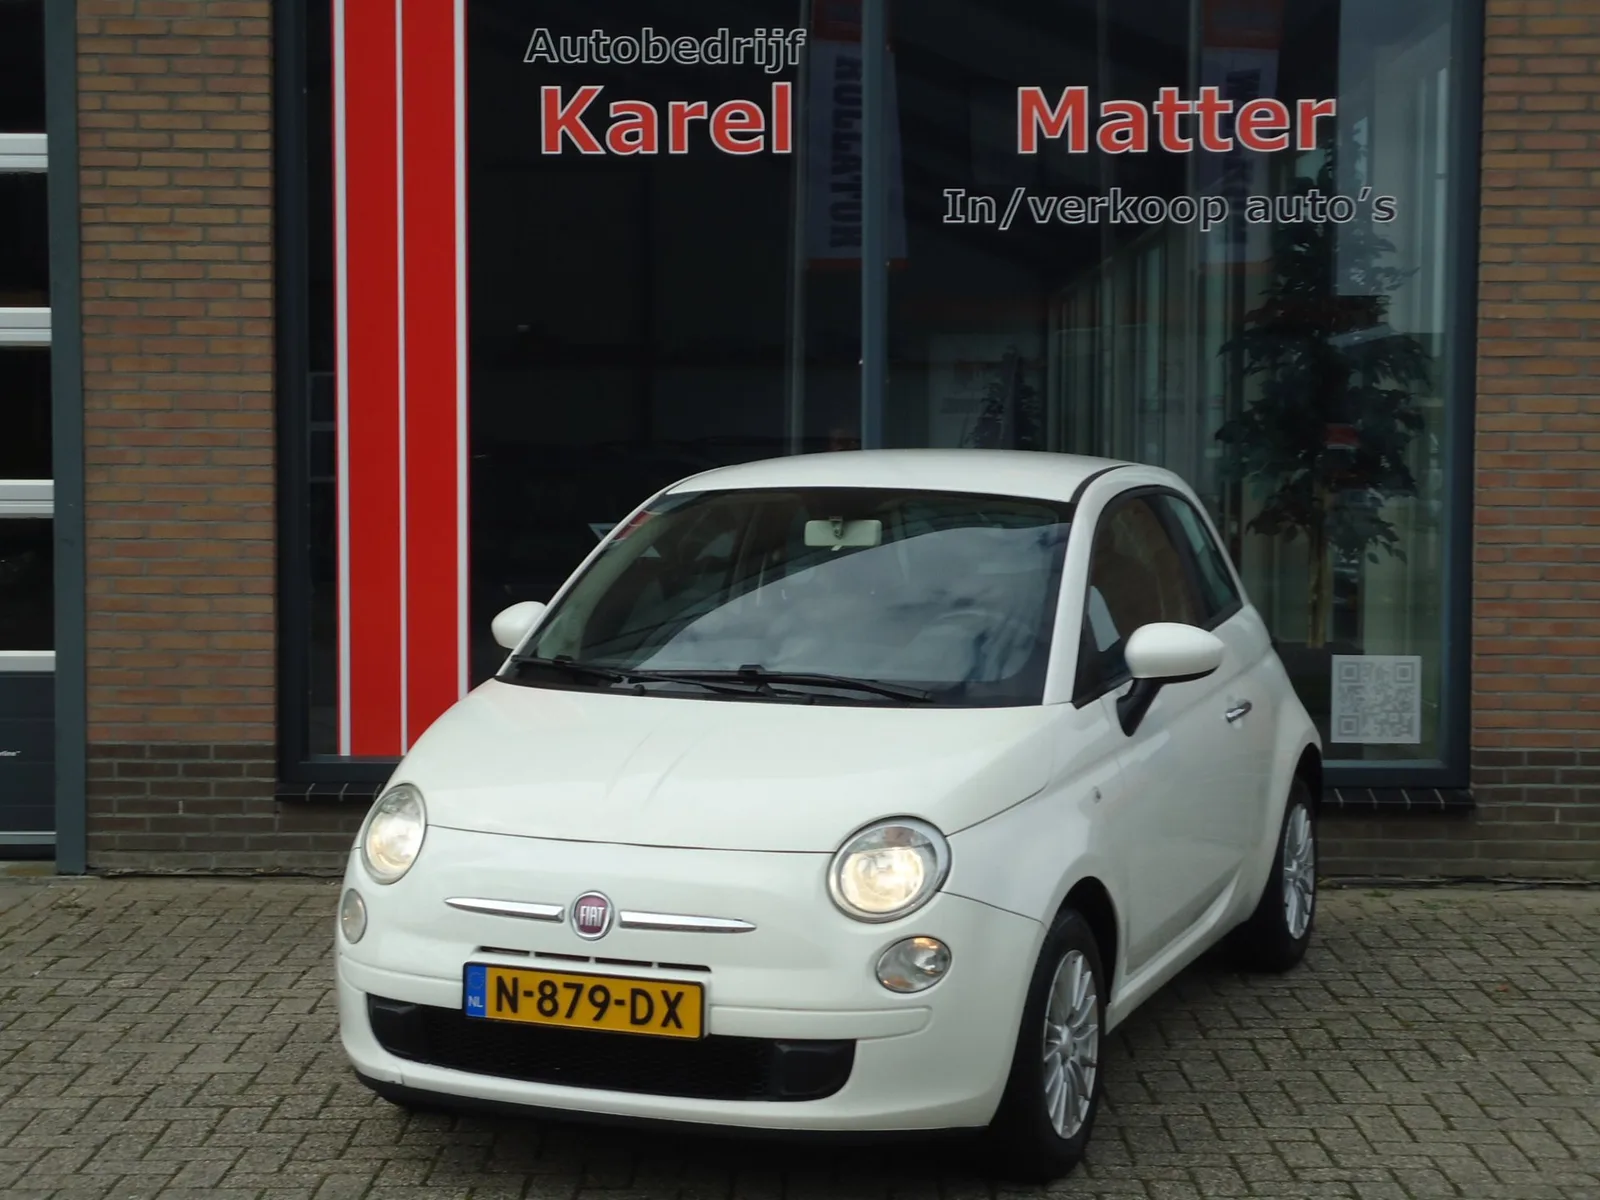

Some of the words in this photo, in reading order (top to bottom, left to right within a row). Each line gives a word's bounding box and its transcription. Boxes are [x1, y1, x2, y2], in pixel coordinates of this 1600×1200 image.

[524, 27, 807, 74] Autobedrijf
[540, 82, 793, 155] Karel
[1017, 86, 1336, 154] Matter
[942, 187, 1230, 232] In/verkoop
[1244, 186, 1398, 224] auto's
[580, 905, 605, 926] FIAT
[468, 995, 484, 1008] NL
[496, 975, 685, 1030] N-879-DX
